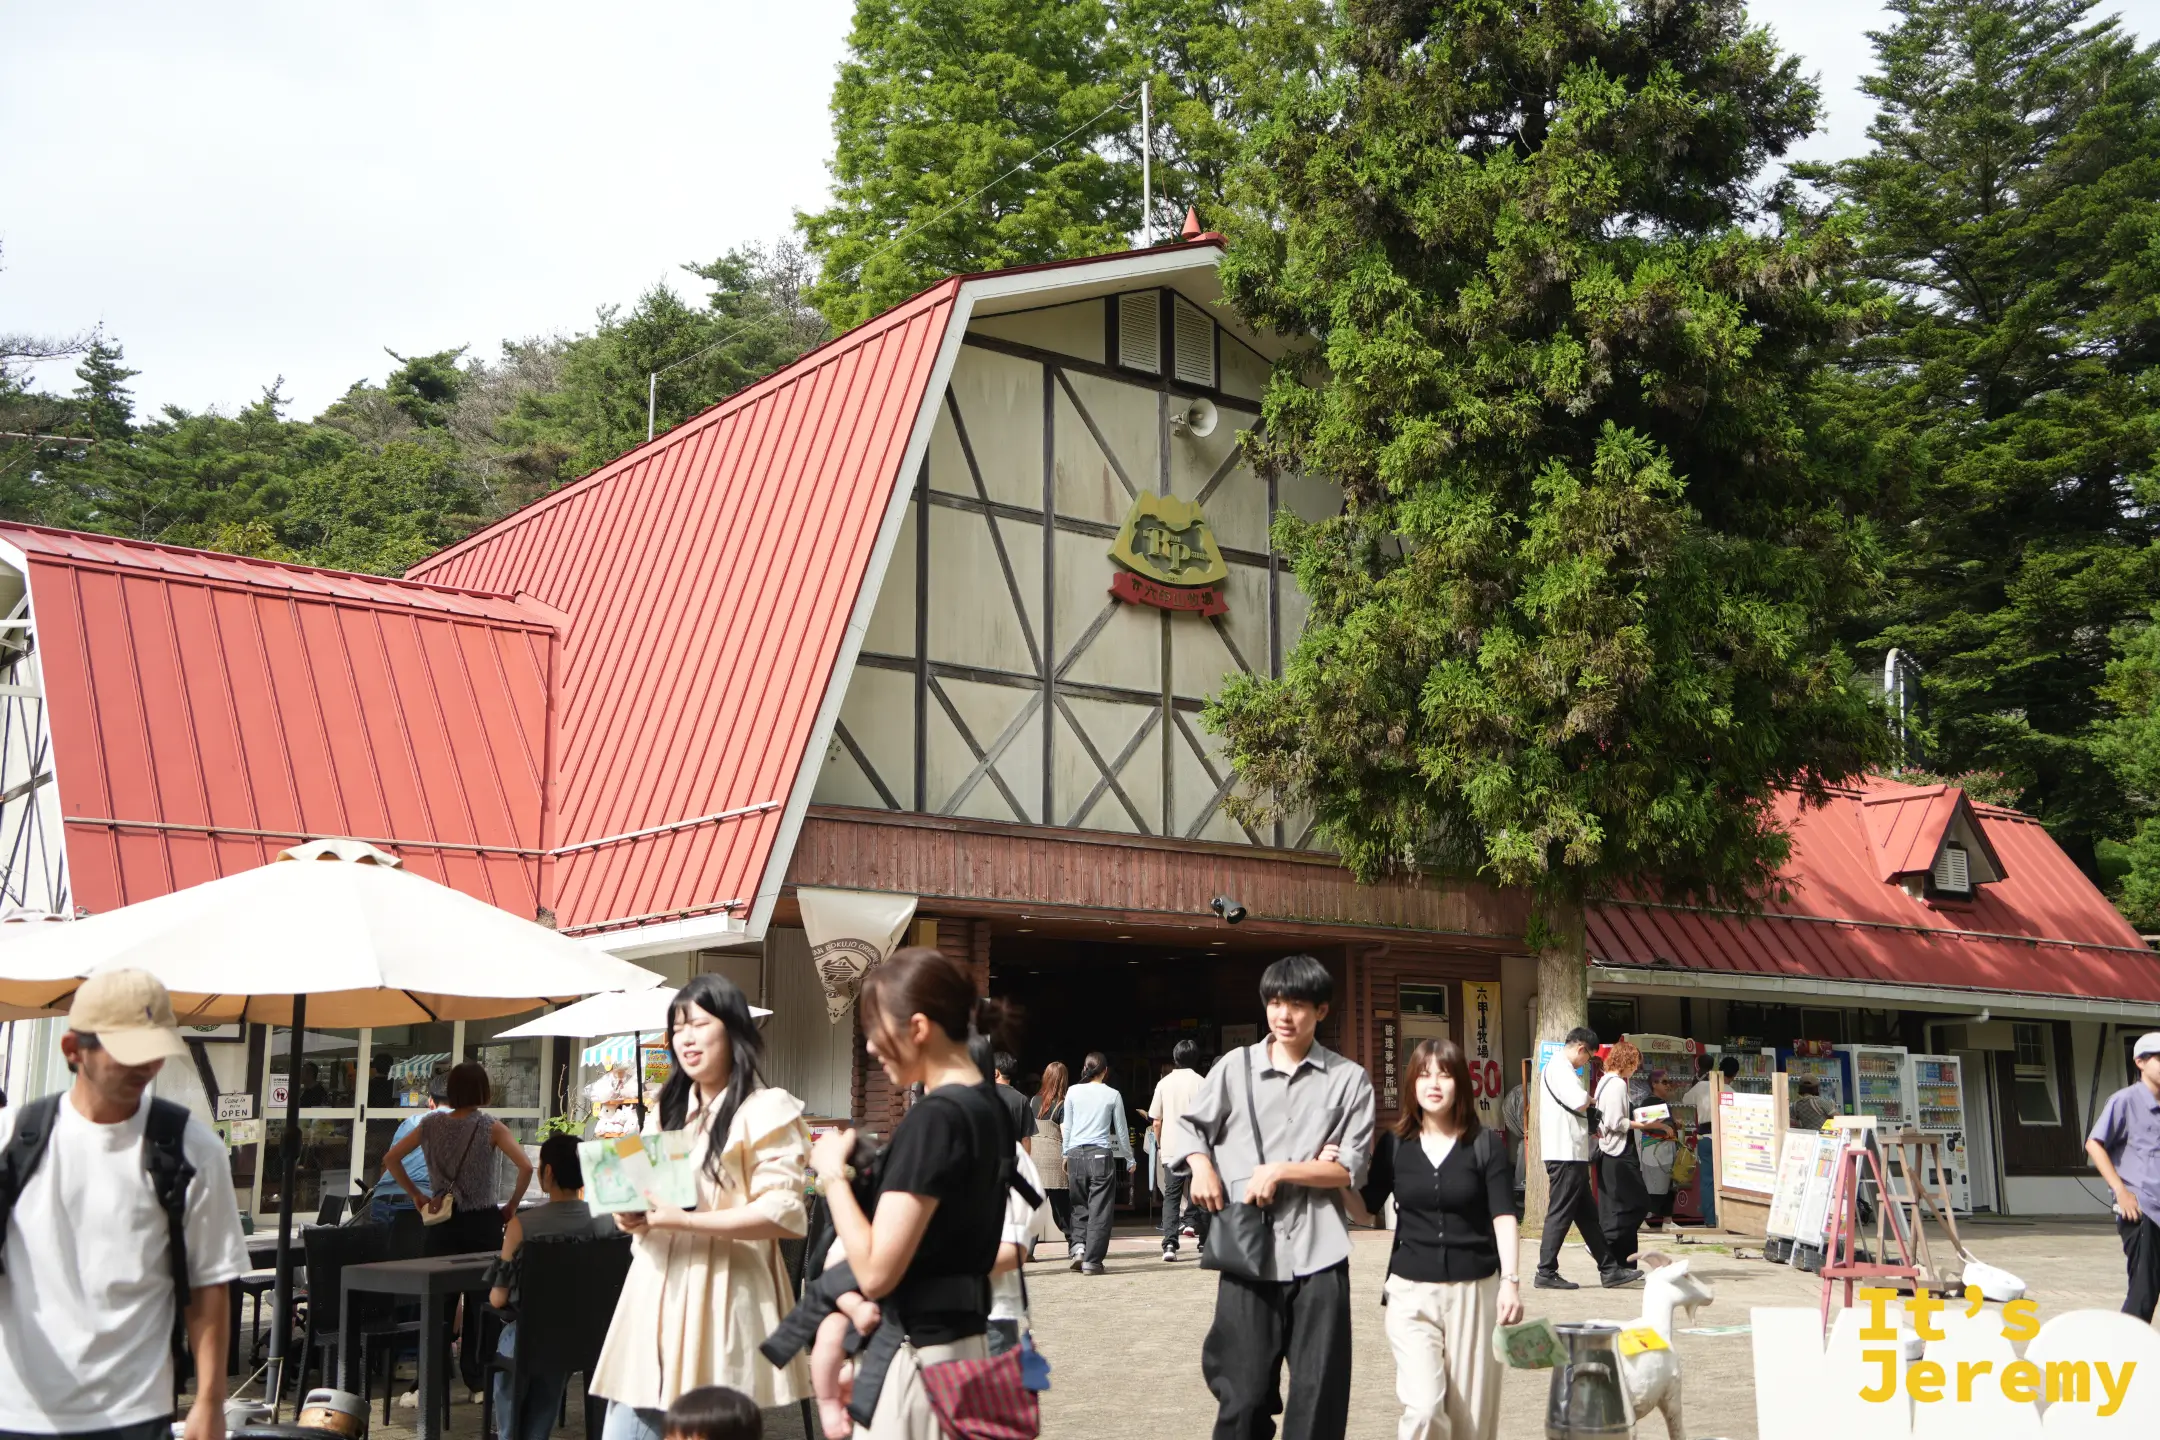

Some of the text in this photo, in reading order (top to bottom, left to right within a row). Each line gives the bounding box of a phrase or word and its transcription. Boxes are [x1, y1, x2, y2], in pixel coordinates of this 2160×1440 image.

[825, 941, 857, 951] BOKUJO
[1477, 986, 1489, 1059] 六甲山牧場
[1384, 1024, 1394, 1087] 管理事務所
[1468, 1060, 1502, 1098] 50
[221, 1109, 248, 1118] OPEN
[1479, 1097, 1490, 1111] th
